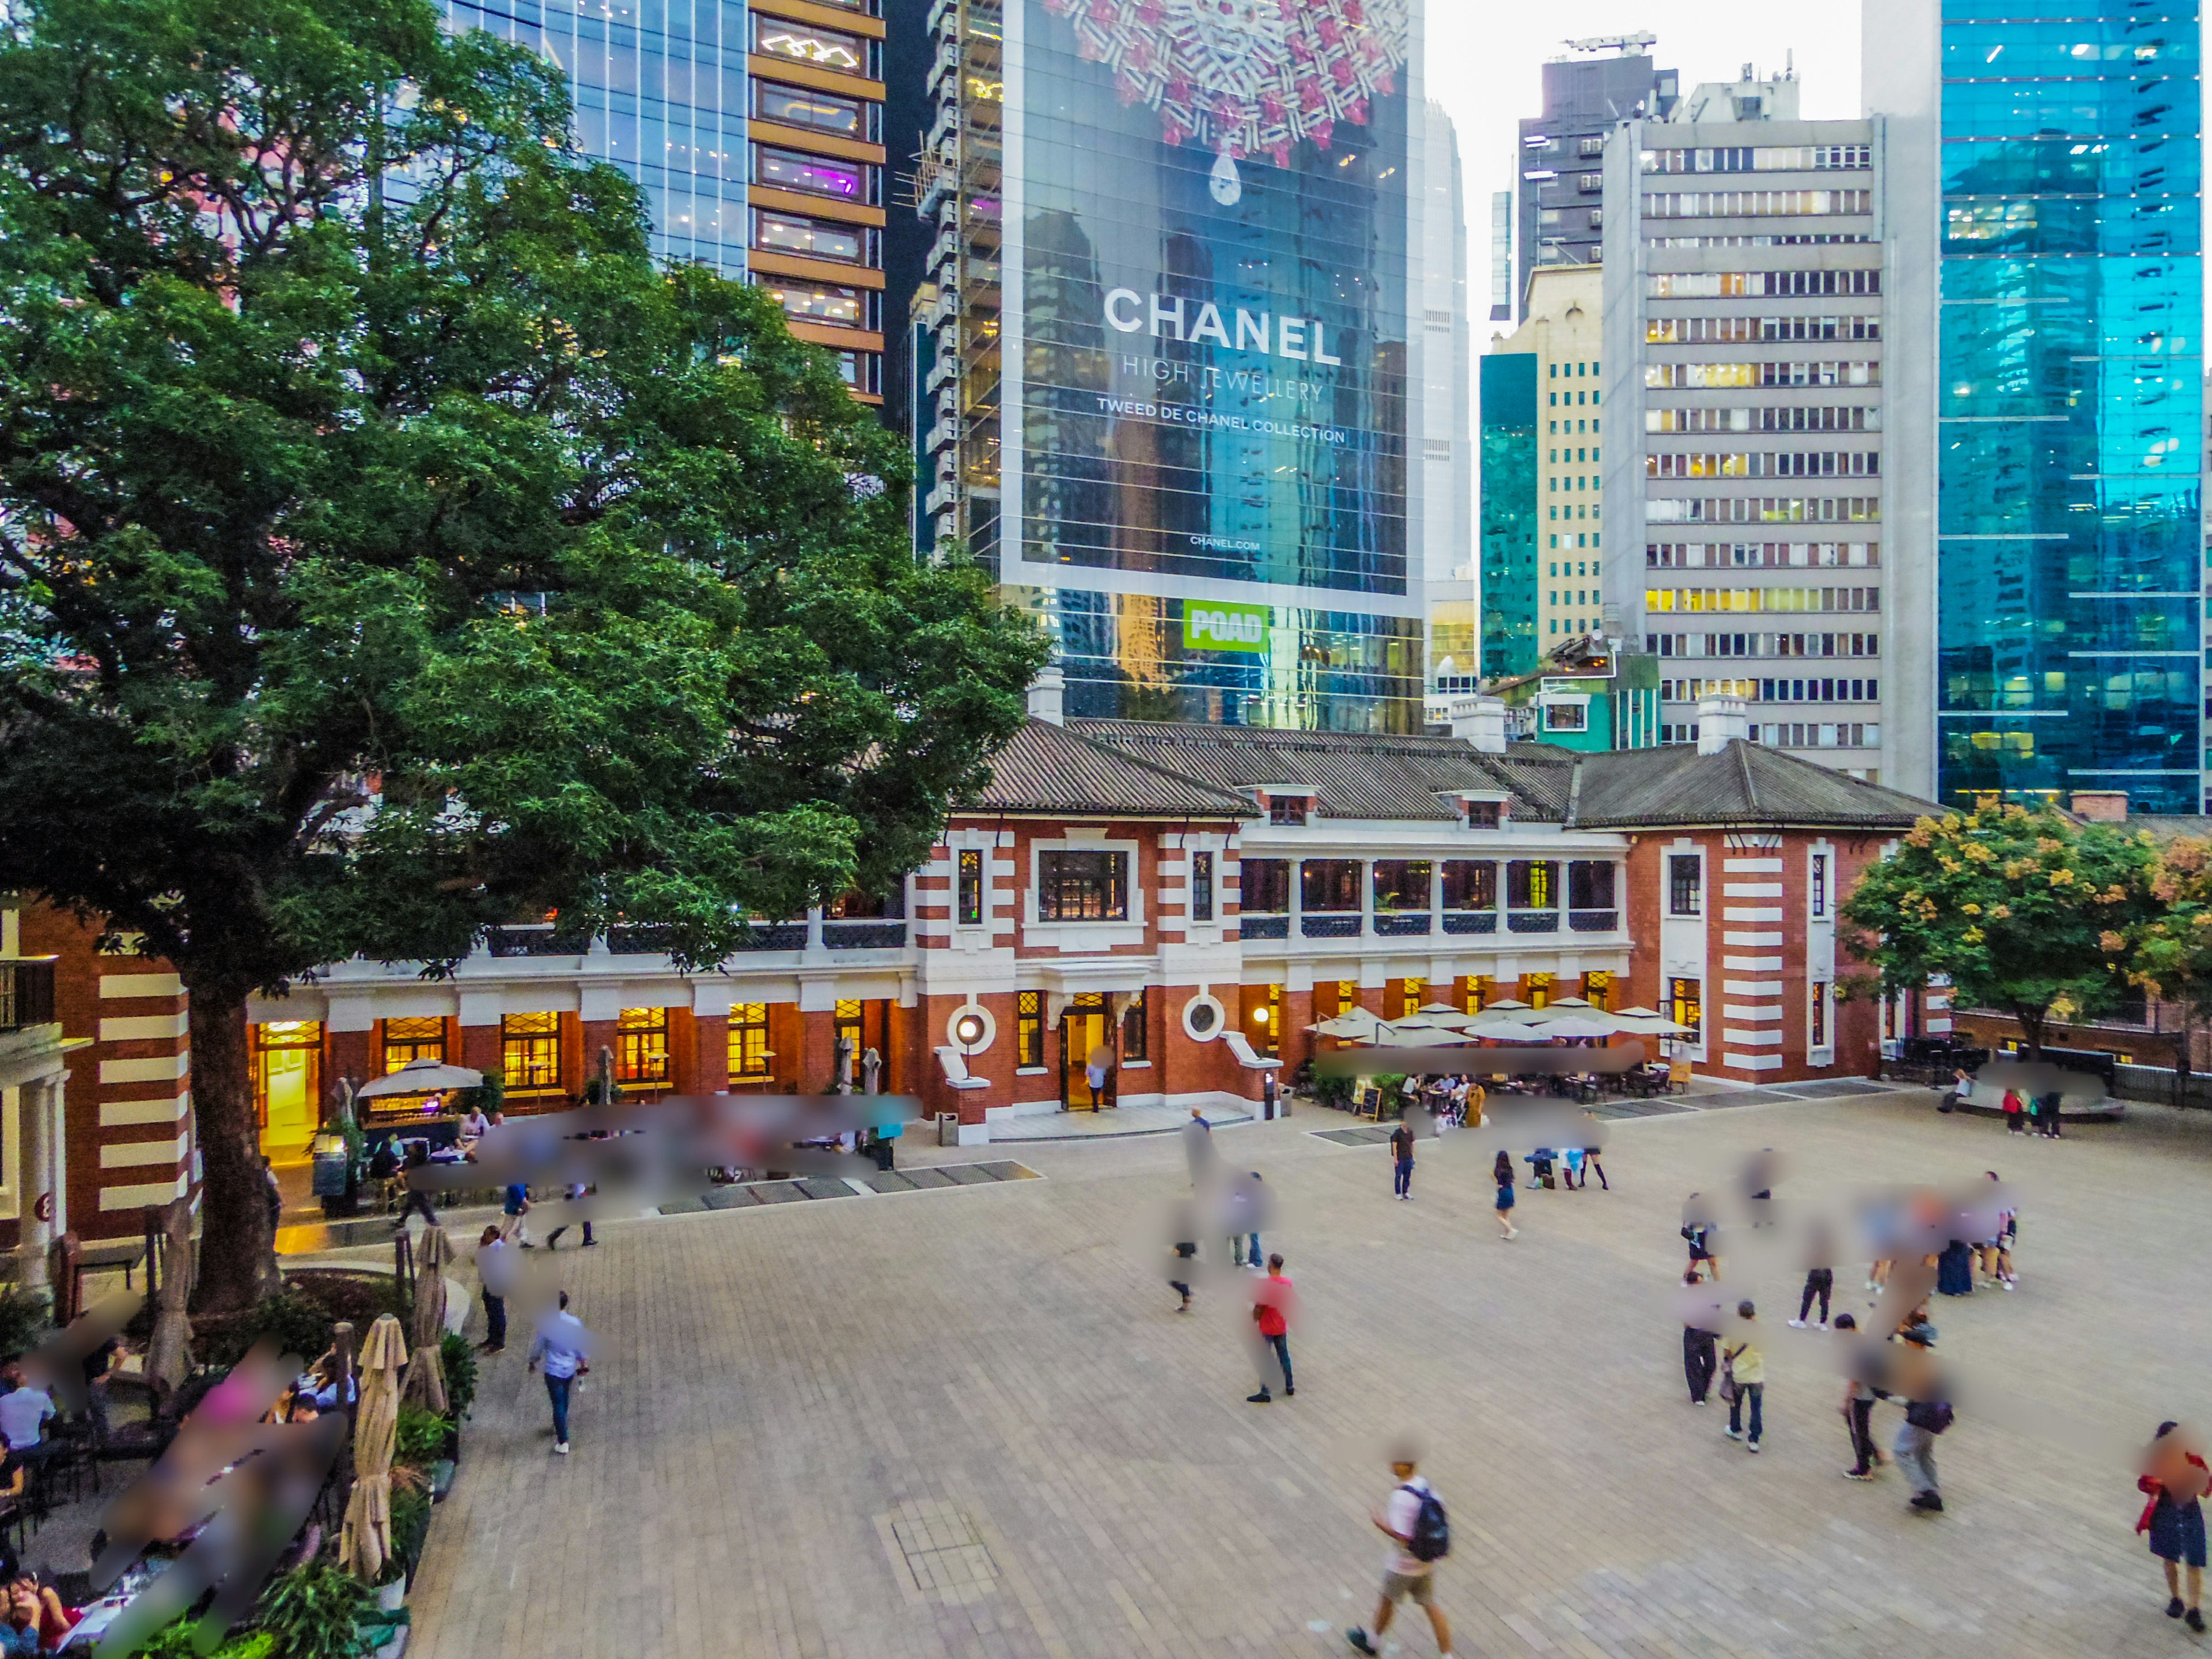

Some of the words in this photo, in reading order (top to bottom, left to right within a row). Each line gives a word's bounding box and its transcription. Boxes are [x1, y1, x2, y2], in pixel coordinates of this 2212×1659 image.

[1103, 288, 1341, 366] CHANEL
[1123, 355, 1189, 383] HIGH
[1200, 367, 1323, 402] JEWELLERY
[1097, 397, 1157, 416] TWEED
[1161, 407, 1183, 421] DE
[1186, 410, 1249, 430] CHANEL
[1252, 419, 1345, 443] COLLECTION
[1190, 536, 1260, 551] CHANEL.COM
[1191, 609, 1262, 643] POAD
